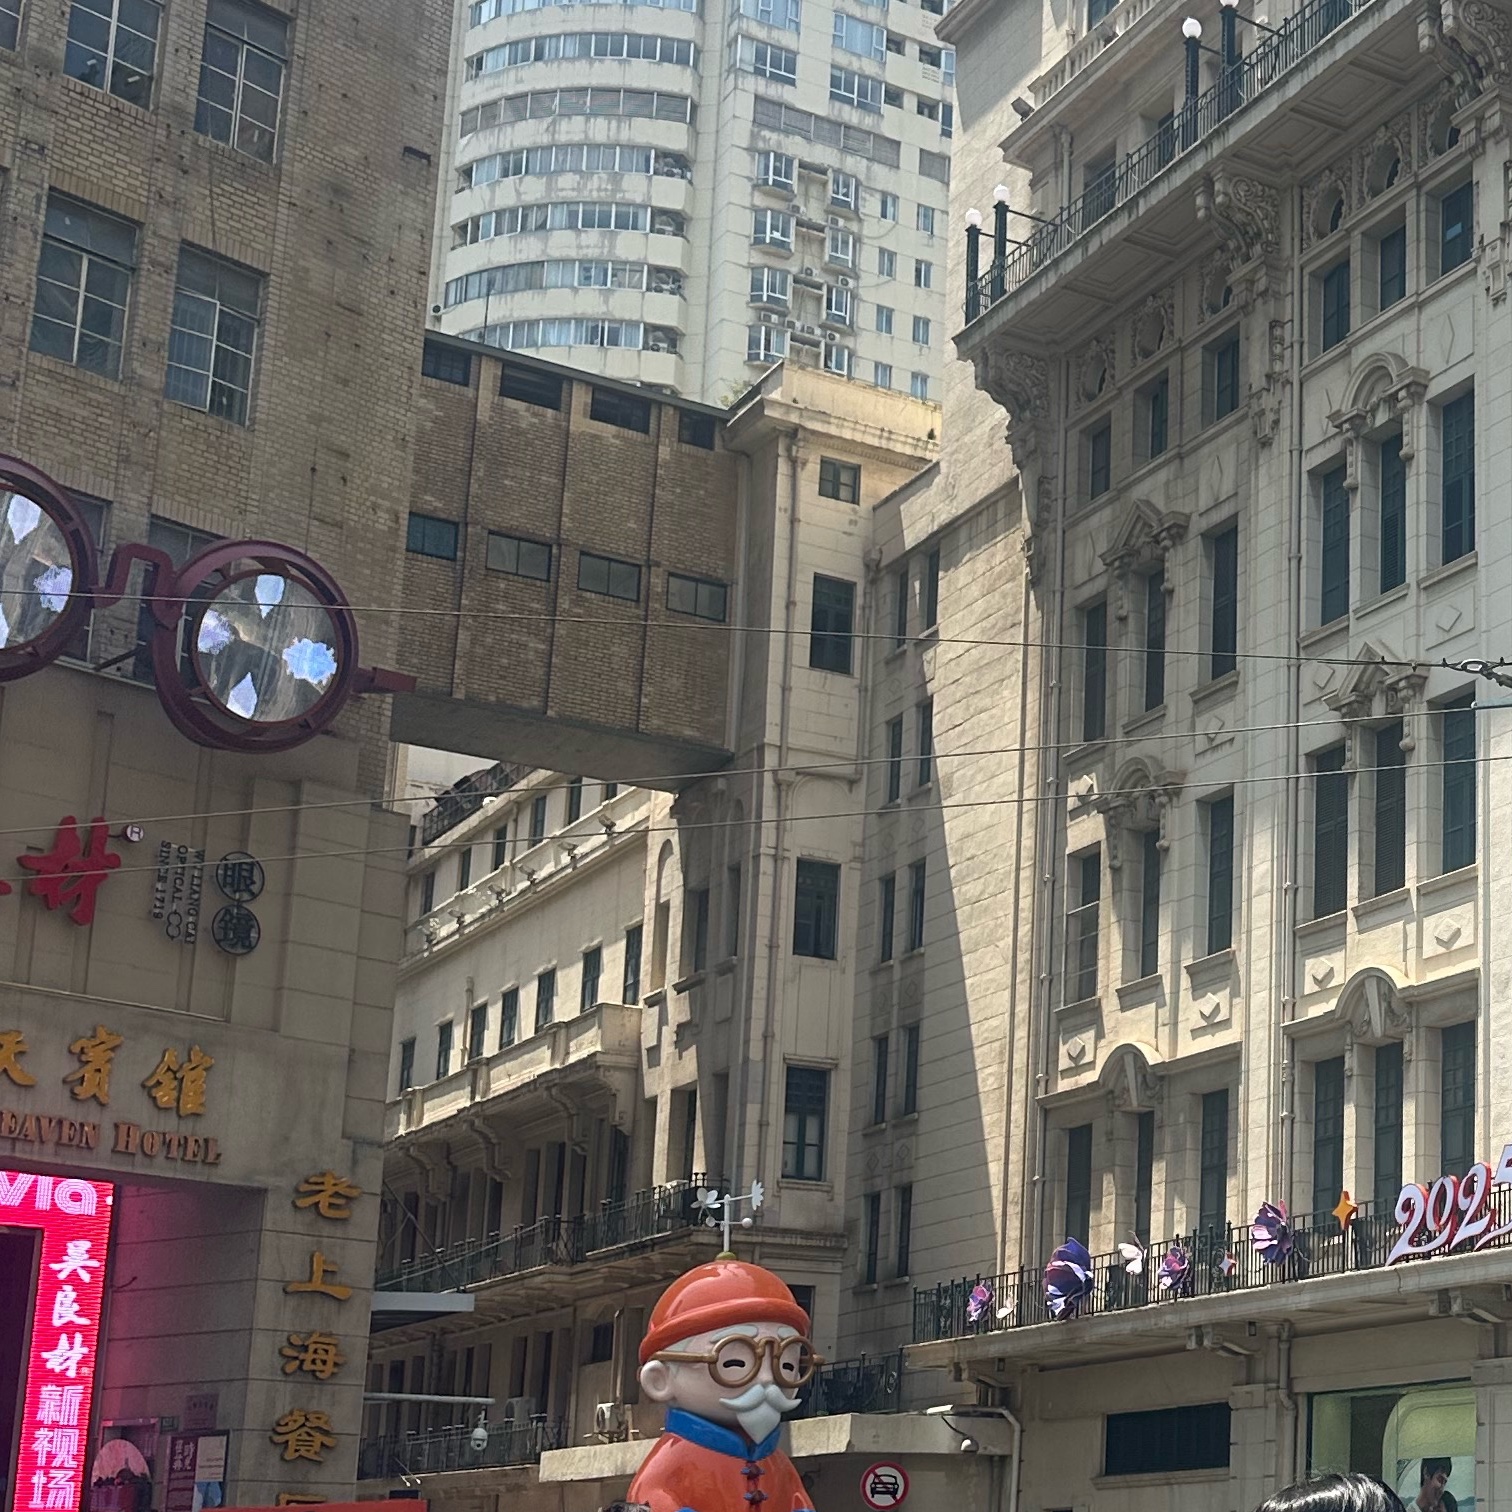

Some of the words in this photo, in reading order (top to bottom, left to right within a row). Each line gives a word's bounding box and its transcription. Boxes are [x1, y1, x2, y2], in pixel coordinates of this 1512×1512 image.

[0, 815, 121, 925] 材
[153, 888, 167, 919] 1719
[114, 1121, 223, 1164] HOTEL
[270, 1169, 362, 1507] 老上海餐
